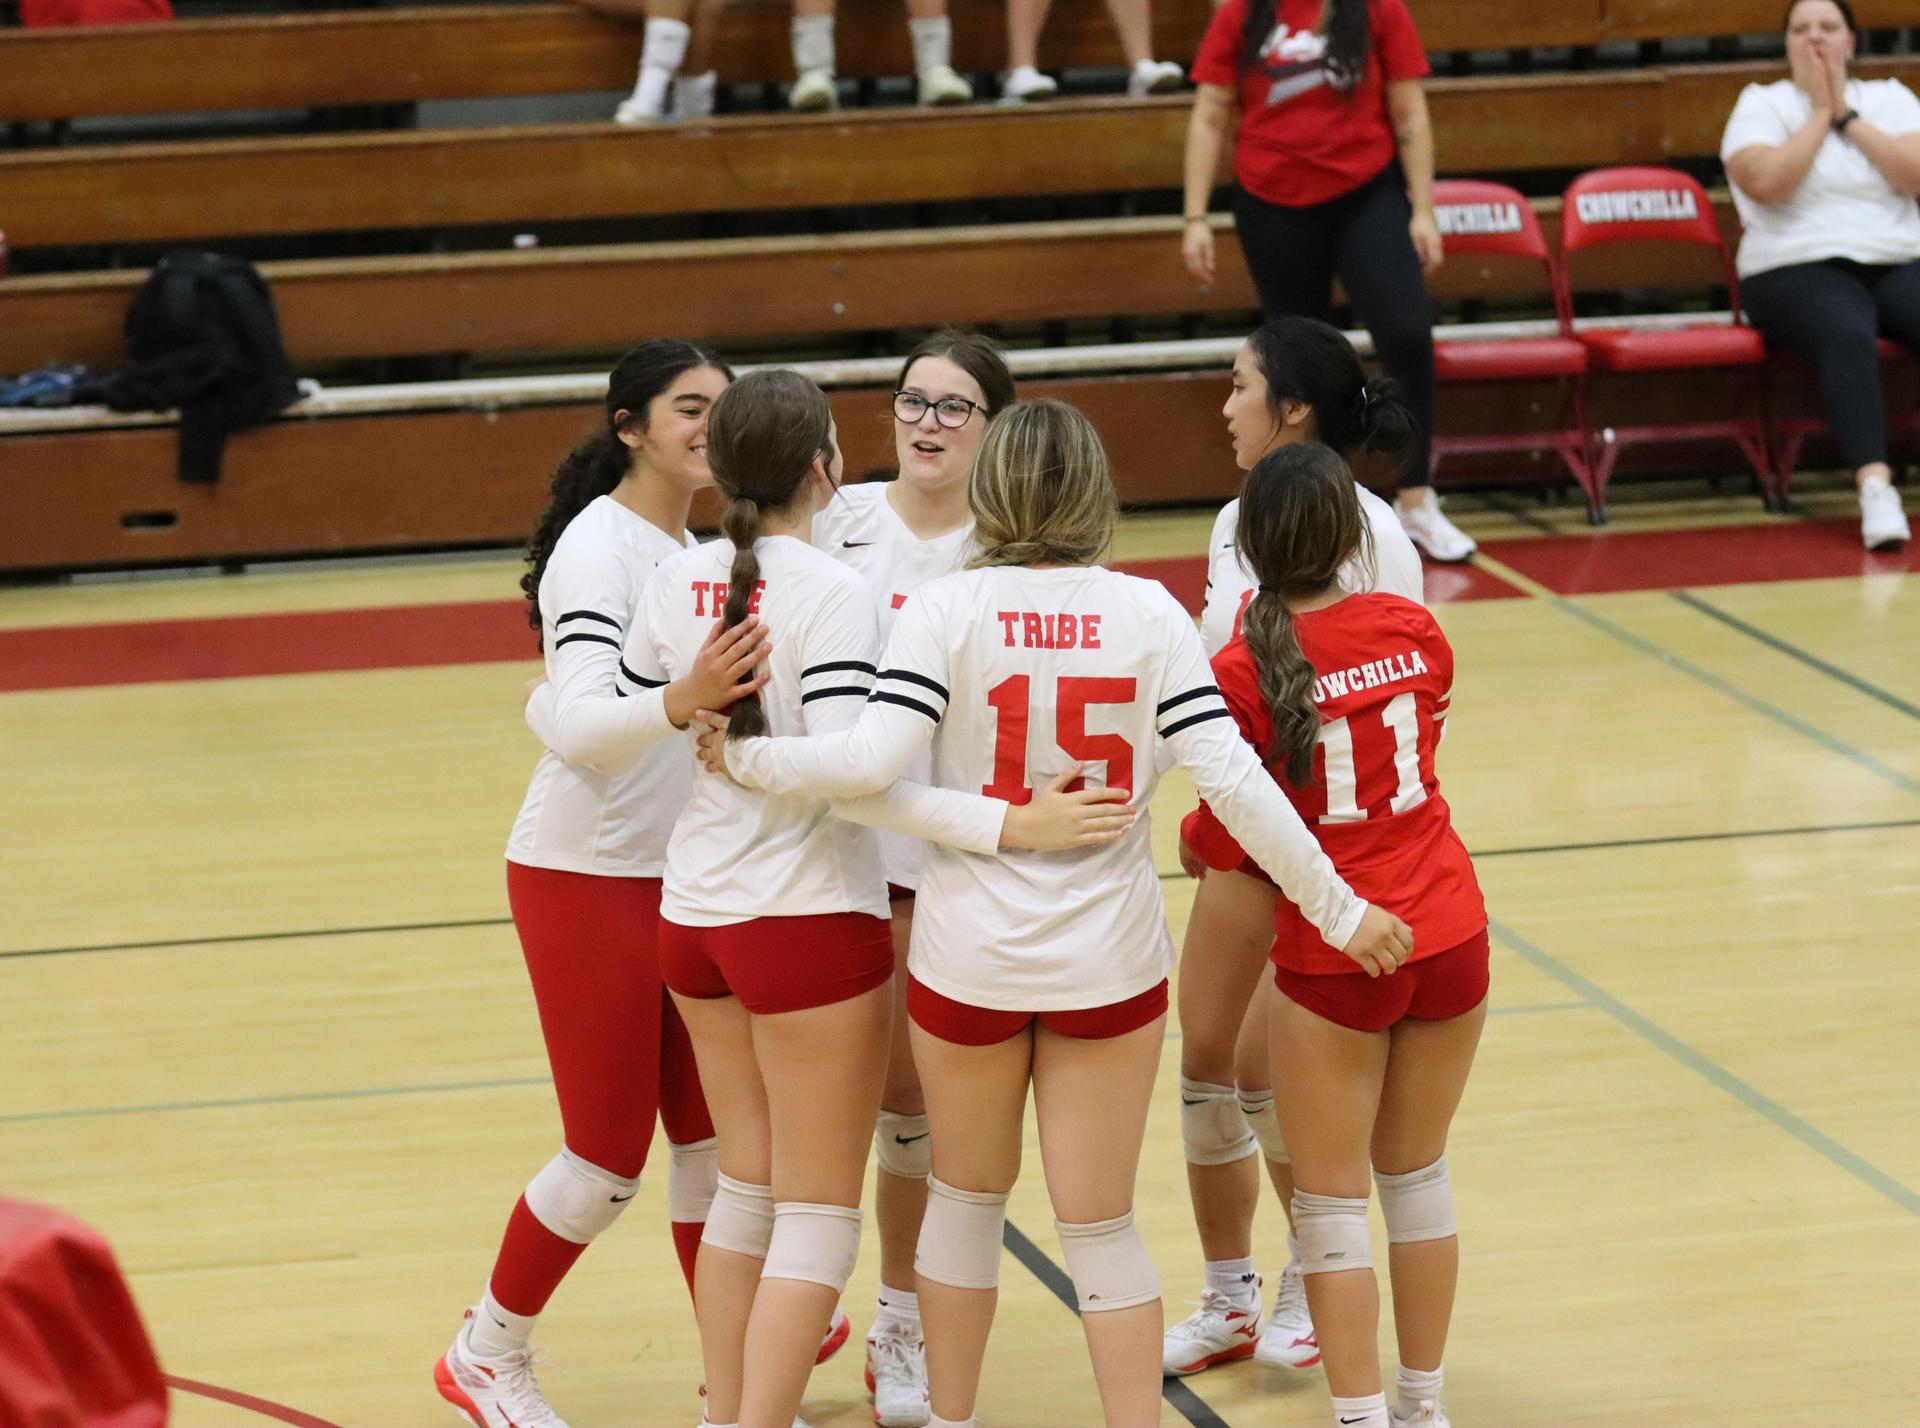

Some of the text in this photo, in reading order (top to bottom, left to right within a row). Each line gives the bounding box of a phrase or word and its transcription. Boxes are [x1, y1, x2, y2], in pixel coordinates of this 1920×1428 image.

[997, 611, 1102, 650] TRIBE
[1312, 650, 1429, 704] OWCHILLA
[981, 673, 1138, 806] 15
[1318, 690, 1429, 826] 11
